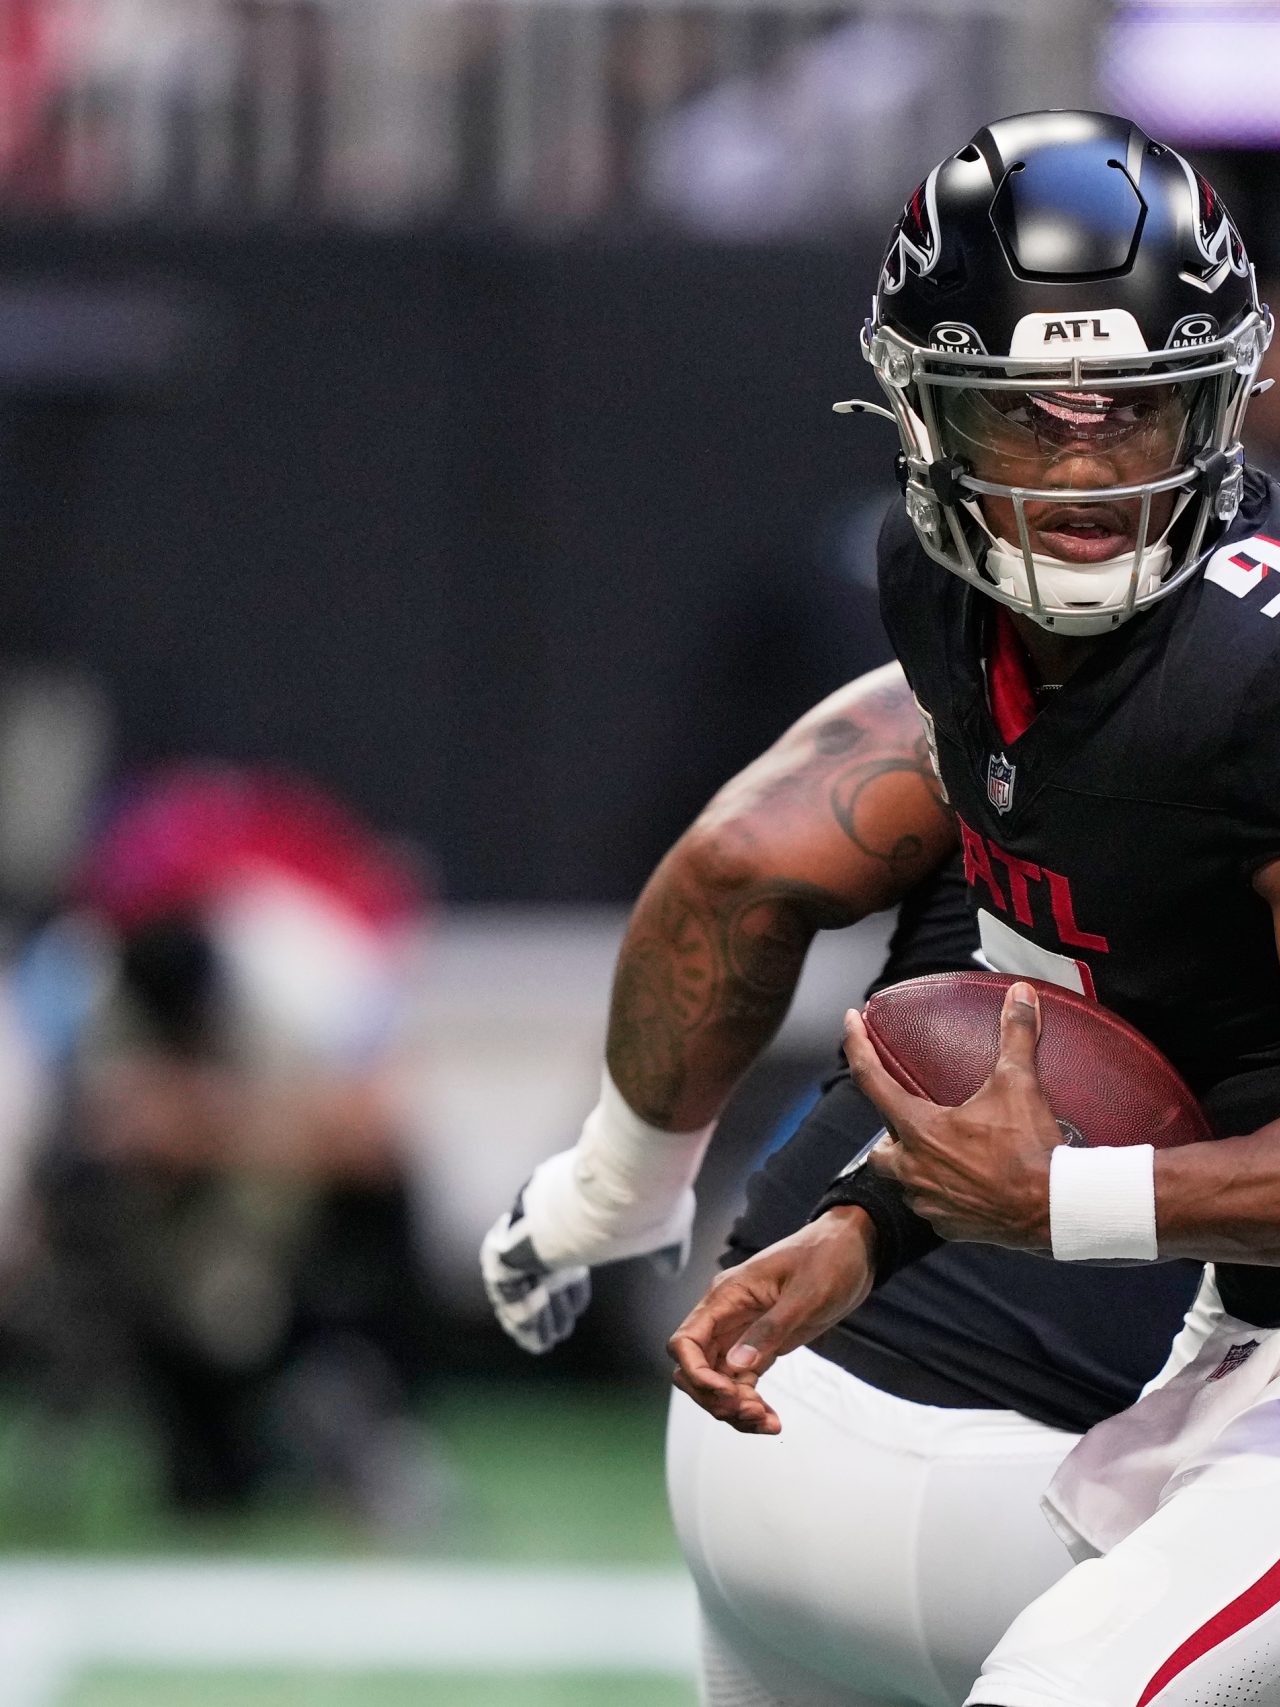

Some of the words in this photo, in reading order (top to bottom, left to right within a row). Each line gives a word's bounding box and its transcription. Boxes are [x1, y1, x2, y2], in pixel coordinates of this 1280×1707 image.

[1044, 319, 1110, 342] ATL
[1173, 335, 1217, 348] OAKLEY
[931, 343, 980, 355] OAKLEY
[990, 777, 1009, 805] NFL
[956, 811, 1109, 953] ATL
